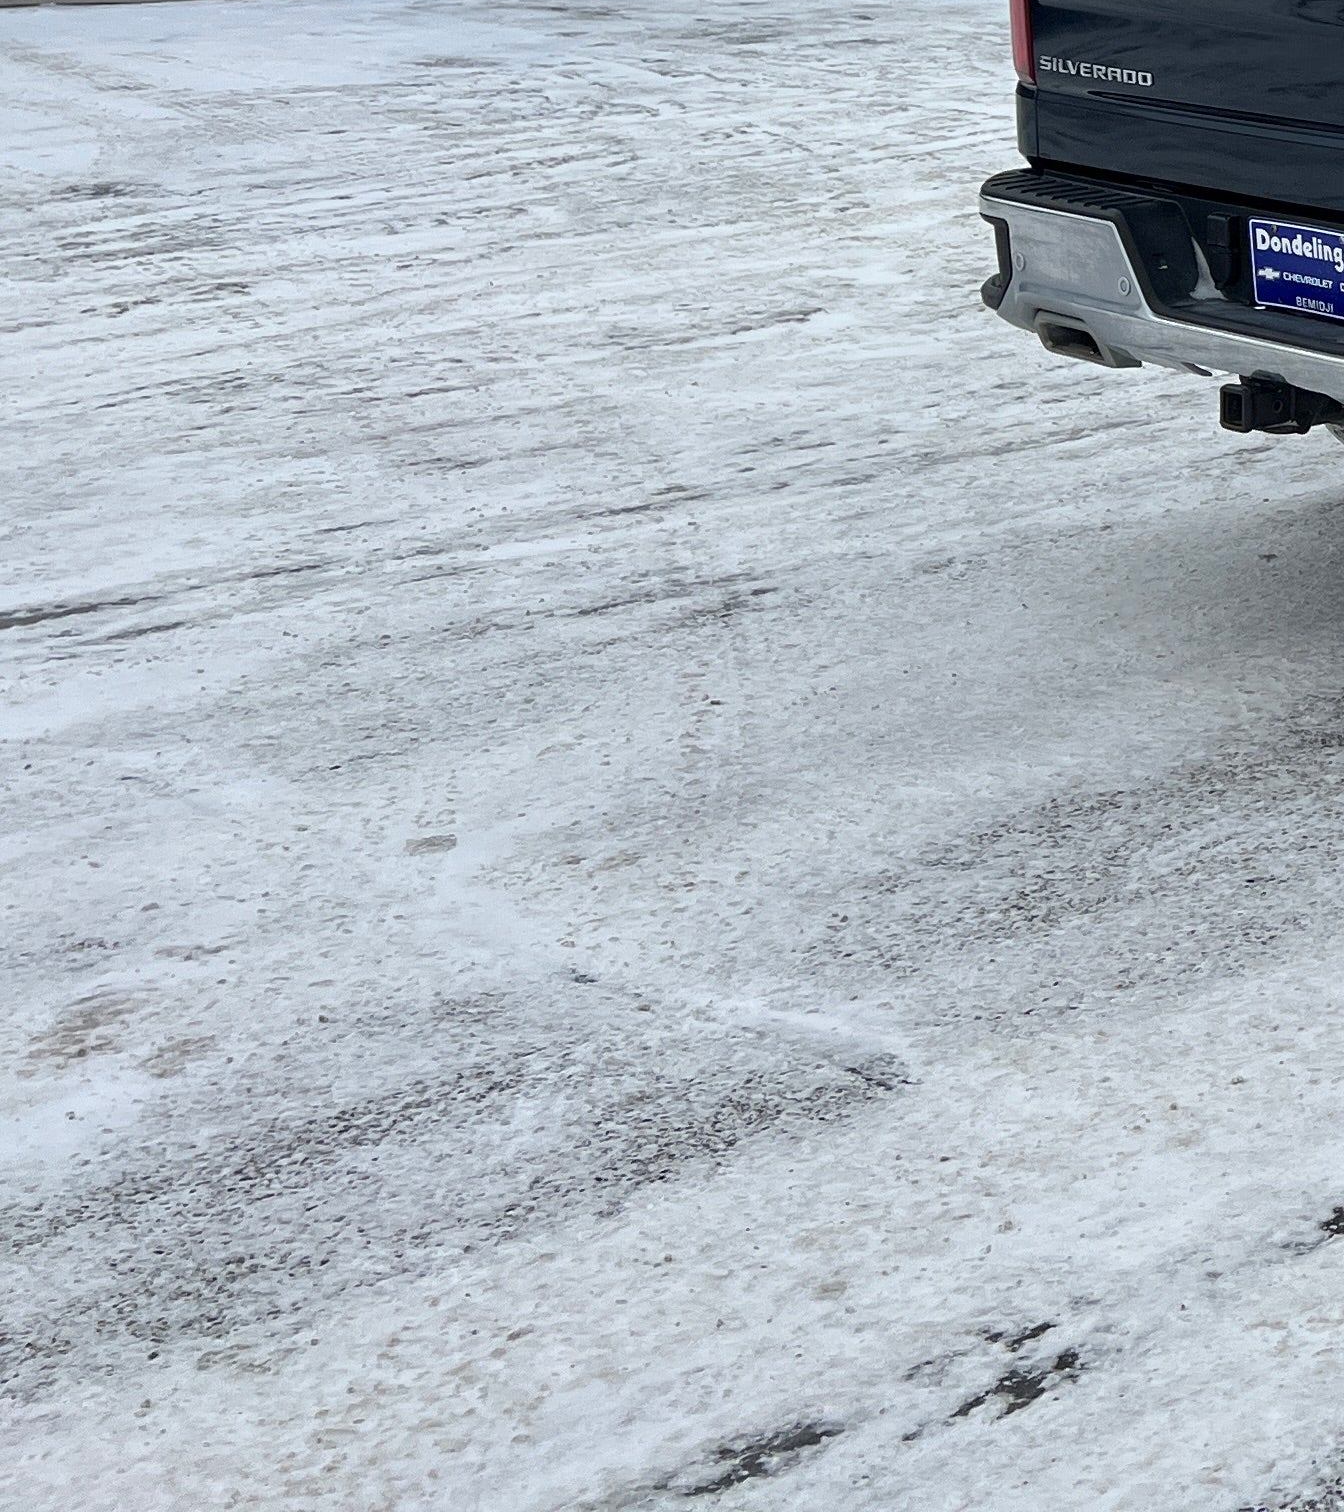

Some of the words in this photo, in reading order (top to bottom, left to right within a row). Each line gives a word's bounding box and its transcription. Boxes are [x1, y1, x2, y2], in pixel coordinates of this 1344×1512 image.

[1039, 55, 1153, 86] SILVERADO
[1282, 271, 1333, 289] CHEVROLET
[1295, 295, 1334, 313] BEMIDJI
